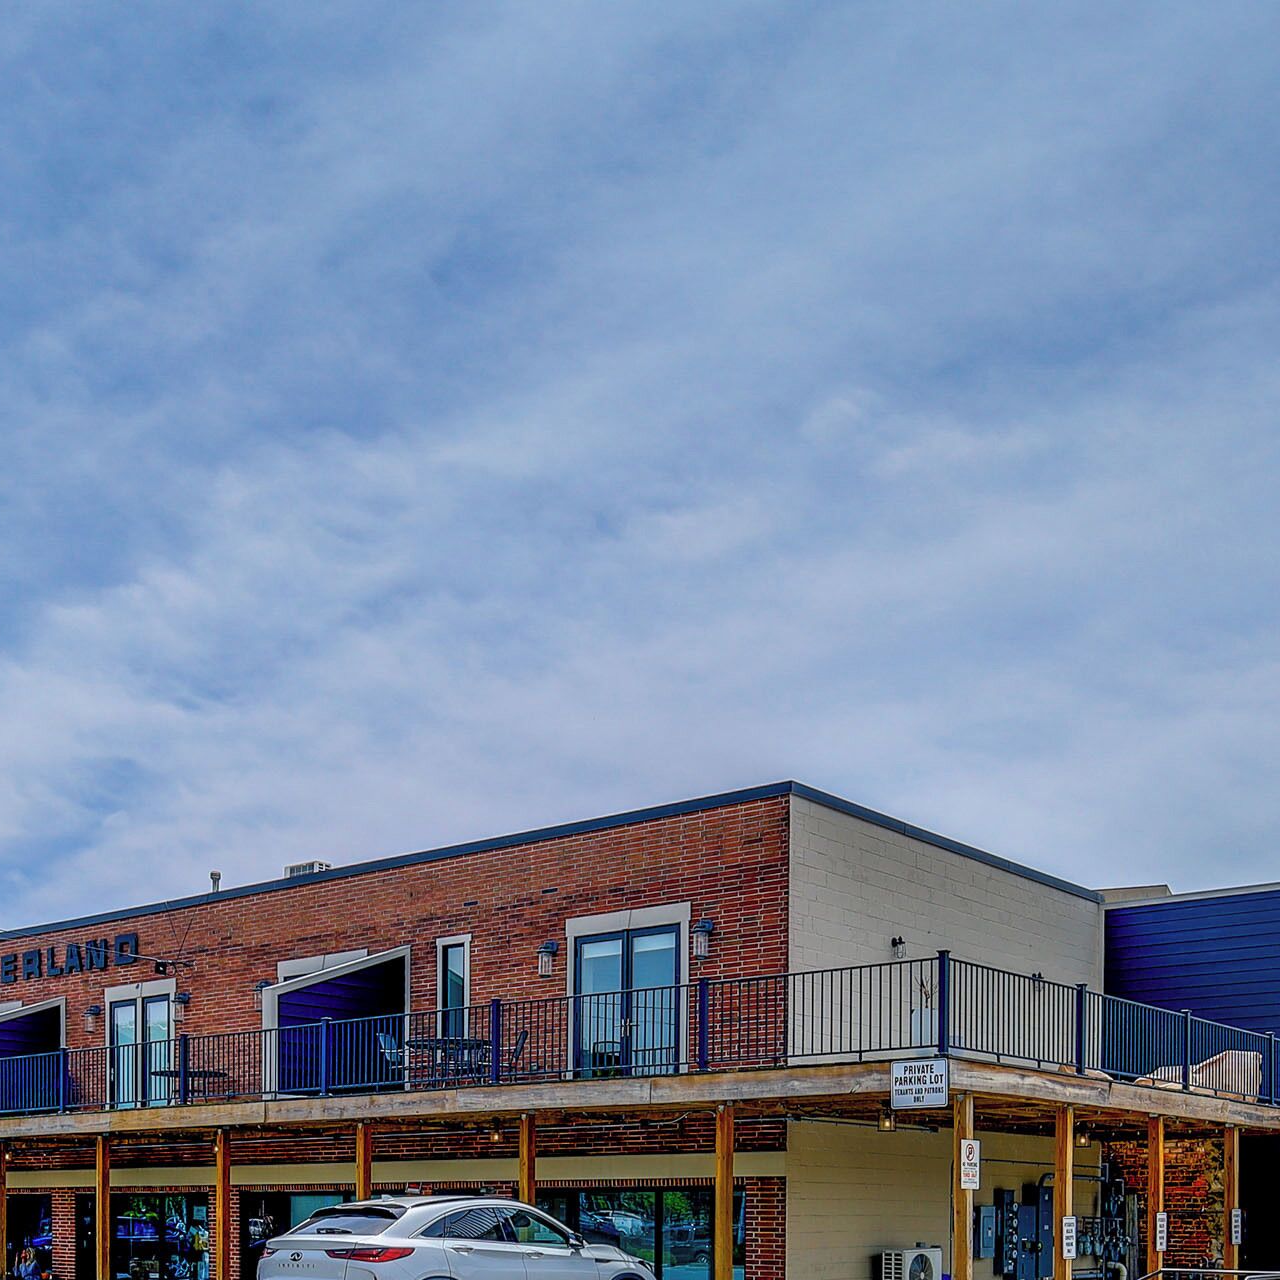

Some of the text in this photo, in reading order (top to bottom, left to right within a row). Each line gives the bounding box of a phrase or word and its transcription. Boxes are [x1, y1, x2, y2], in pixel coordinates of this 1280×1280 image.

[904, 1064, 934, 1075] PRIVATE
[895, 1074, 944, 1086] PARKING LOT
